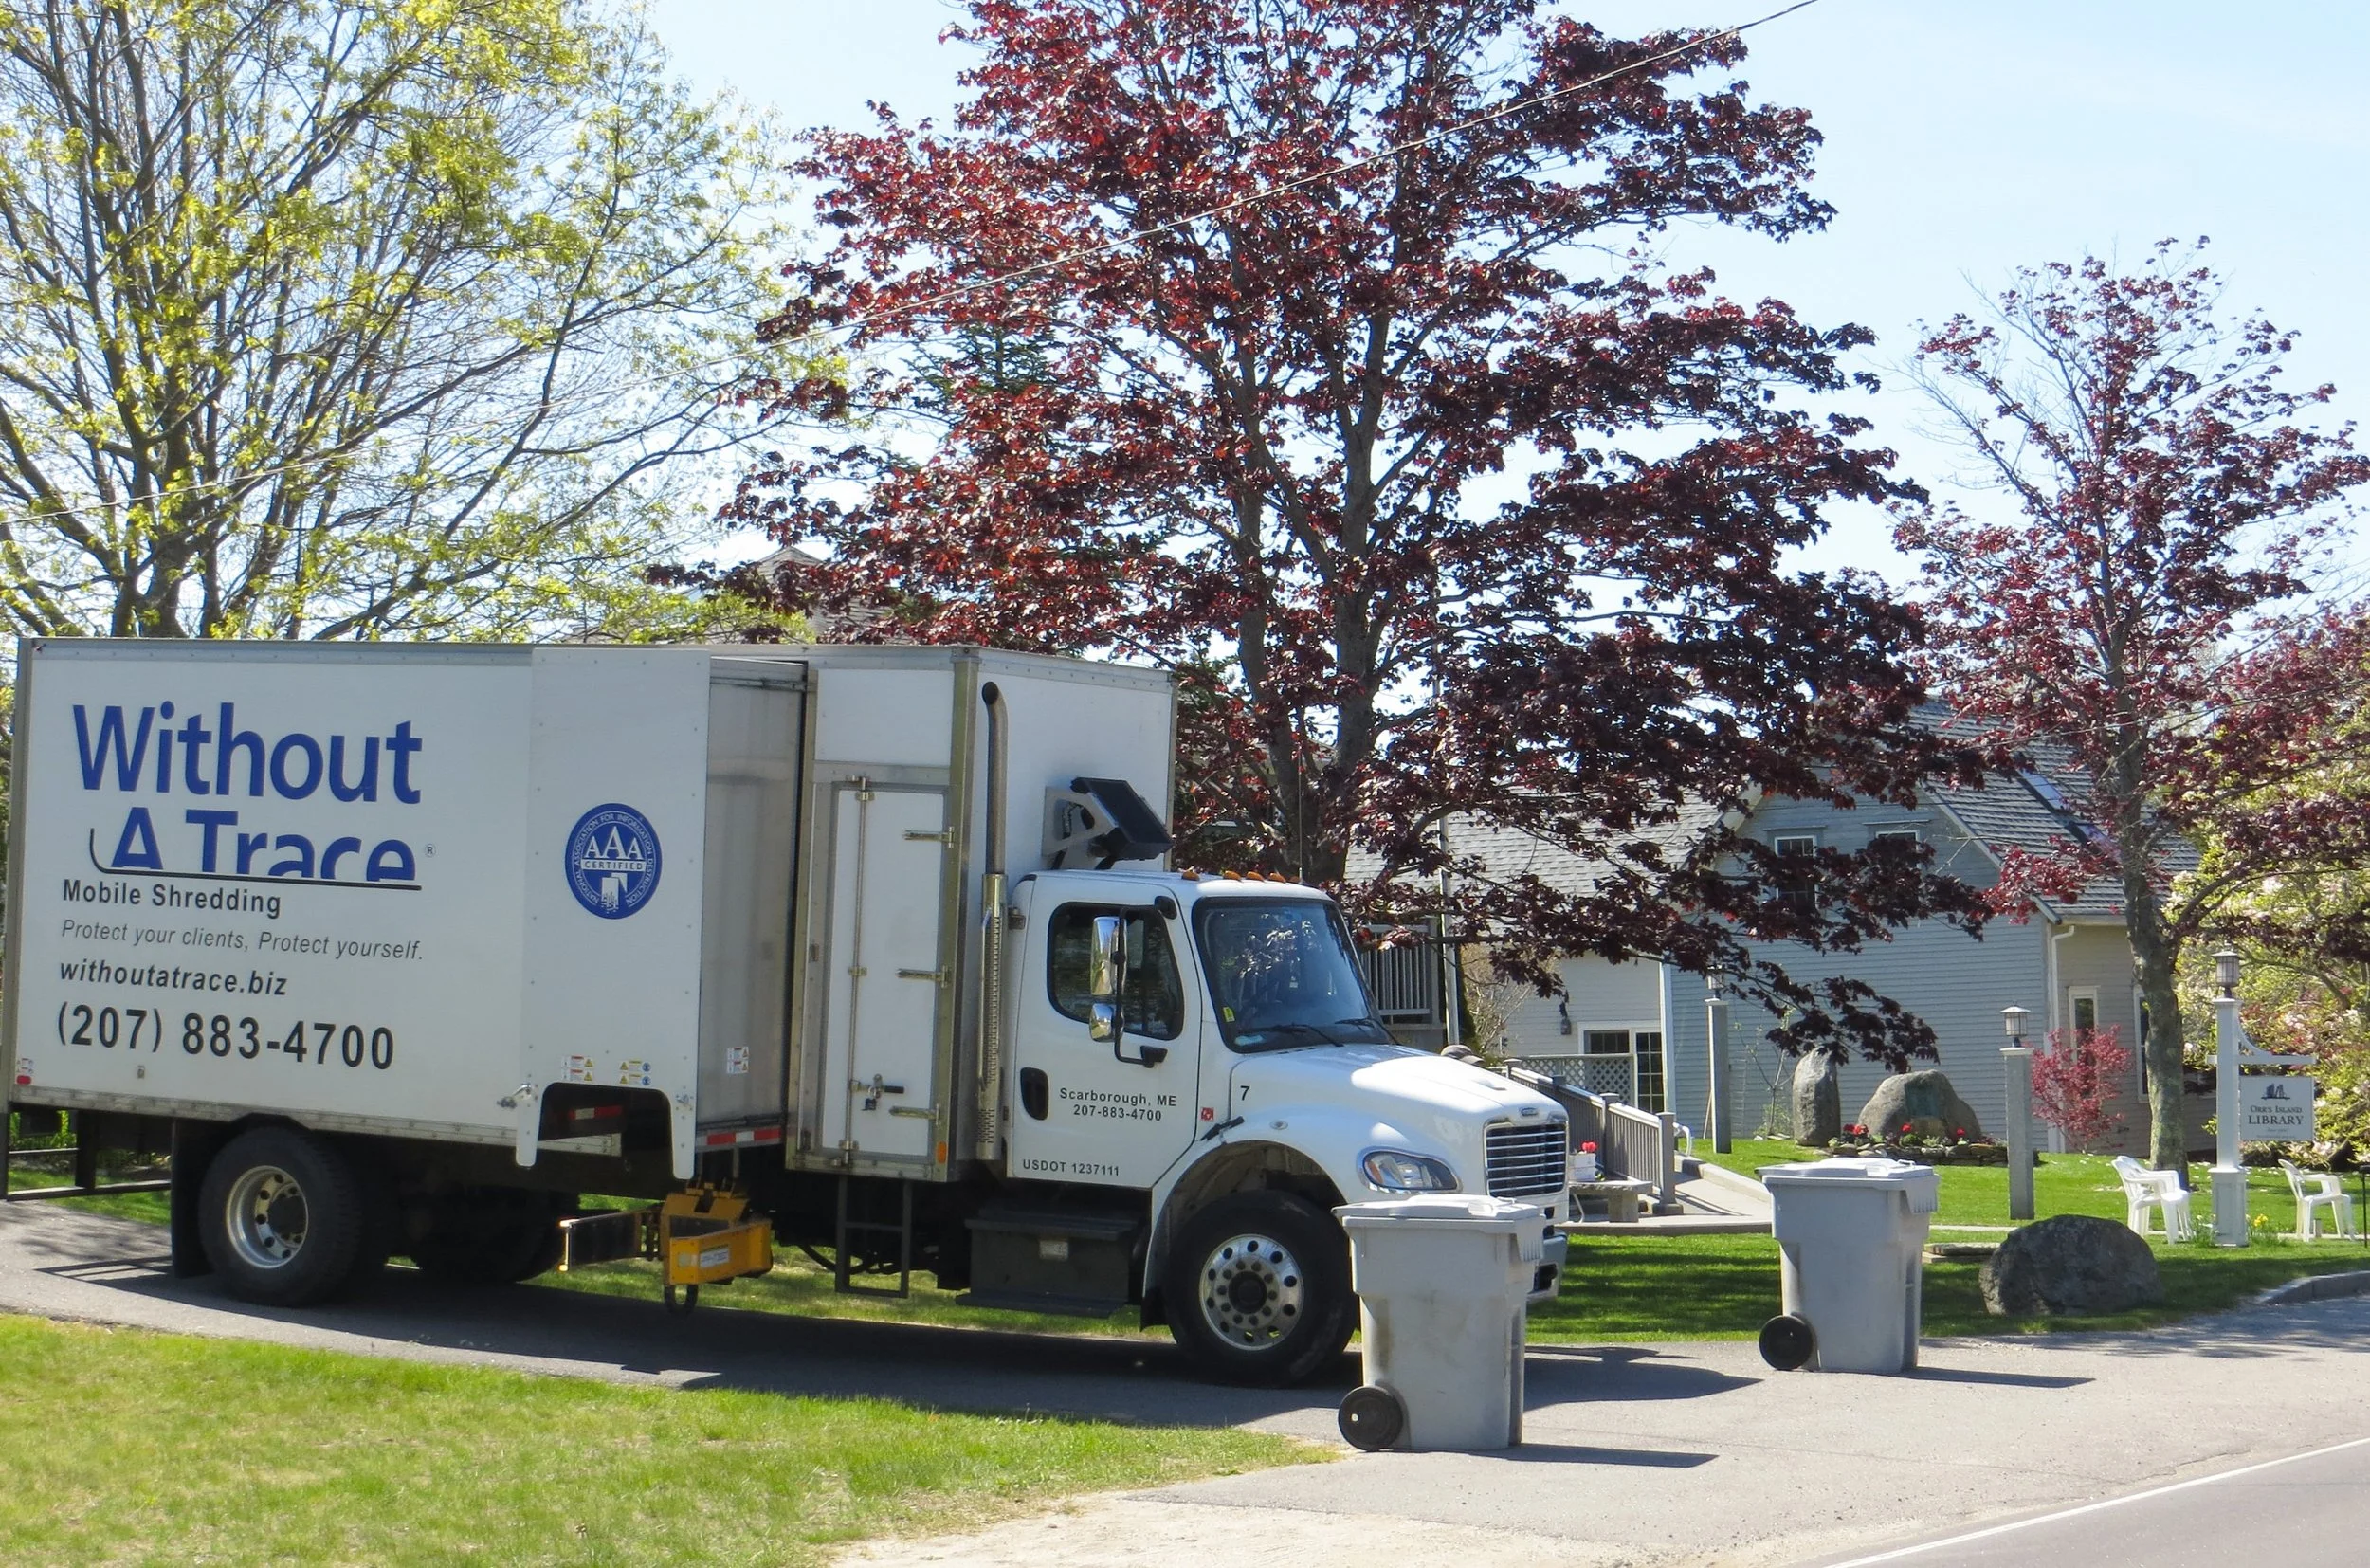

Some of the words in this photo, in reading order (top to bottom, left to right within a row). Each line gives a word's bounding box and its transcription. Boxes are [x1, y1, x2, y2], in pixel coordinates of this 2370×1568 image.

[73, 701, 422, 804] Without
[601, 813, 614, 822] FOR
[617, 813, 653, 855] INFORMATION
[111, 807, 163, 870] A
[185, 810, 416, 883] Trace
[574, 820, 599, 866] ASSOCIATION
[583, 826, 644, 861] AAA
[584, 860, 643, 870] CERTIFIED
[626, 858, 654, 904] DESTRUCTION
[64, 879, 141, 905] Mobile
[152, 883, 282, 920] Shredding
[62, 920, 127, 941] Protect
[134, 928, 175, 947] your
[183, 929, 248, 952] clients,
[258, 932, 329, 955] Protect
[336, 940, 423, 960] yourself.
[61, 958, 287, 996] withoutatrace.biz
[58, 1001, 163, 1052] (207)
[182, 1012, 394, 1070] 883-4700
[1060, 1087, 1151, 1107] Scarborough,
[1157, 1094, 1176, 1107] ME
[1073, 1103, 1162, 1121] 207-883-4700
[1240, 1085, 1250, 1101] 7
[2248, 1115, 2304, 1125] LIBRARY
[1023, 1158, 1066, 1173] USDOT
[1072, 1162, 1119, 1176] 1237111
